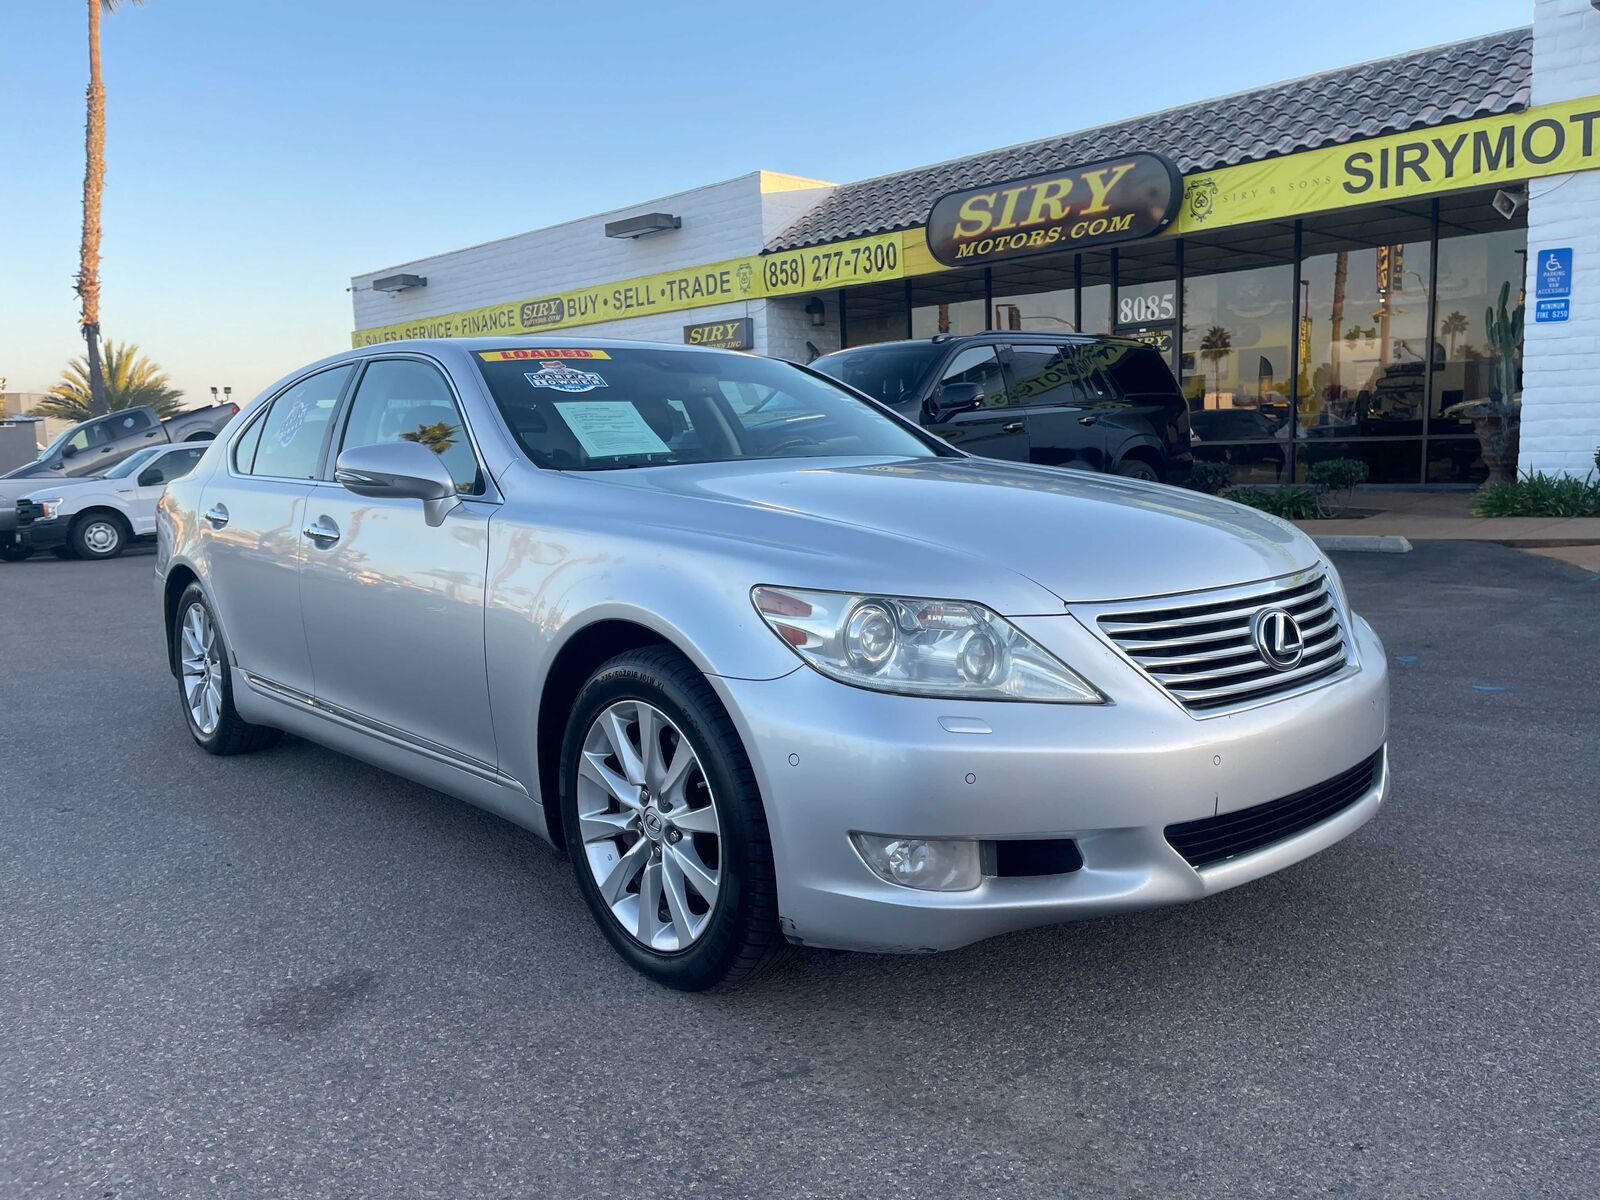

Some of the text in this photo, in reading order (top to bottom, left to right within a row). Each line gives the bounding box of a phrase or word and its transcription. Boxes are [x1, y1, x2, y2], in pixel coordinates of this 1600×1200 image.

[1342, 110, 1600, 194] SIRYMOT
[952, 162, 1137, 239] SIRY
[1223, 190, 1257, 202] SIRY
[1288, 176, 1332, 191] SONS
[955, 213, 1136, 259] MOTORS.COM
[763, 241, 897, 292] (858) 277-7300
[567, 271, 731, 318] BUY SELL TRADE
[1120, 293, 1174, 322] 8085
[1541, 302, 1566, 310] MINIMUM
[523, 300, 561, 319] SIRY
[1537, 310, 1568, 319] FINE $250
[405, 321, 452, 340] SERVICE
[461, 309, 515, 336] FINANCE
[689, 322, 740, 345] SIRY
[500, 349, 593, 360] LOADED
